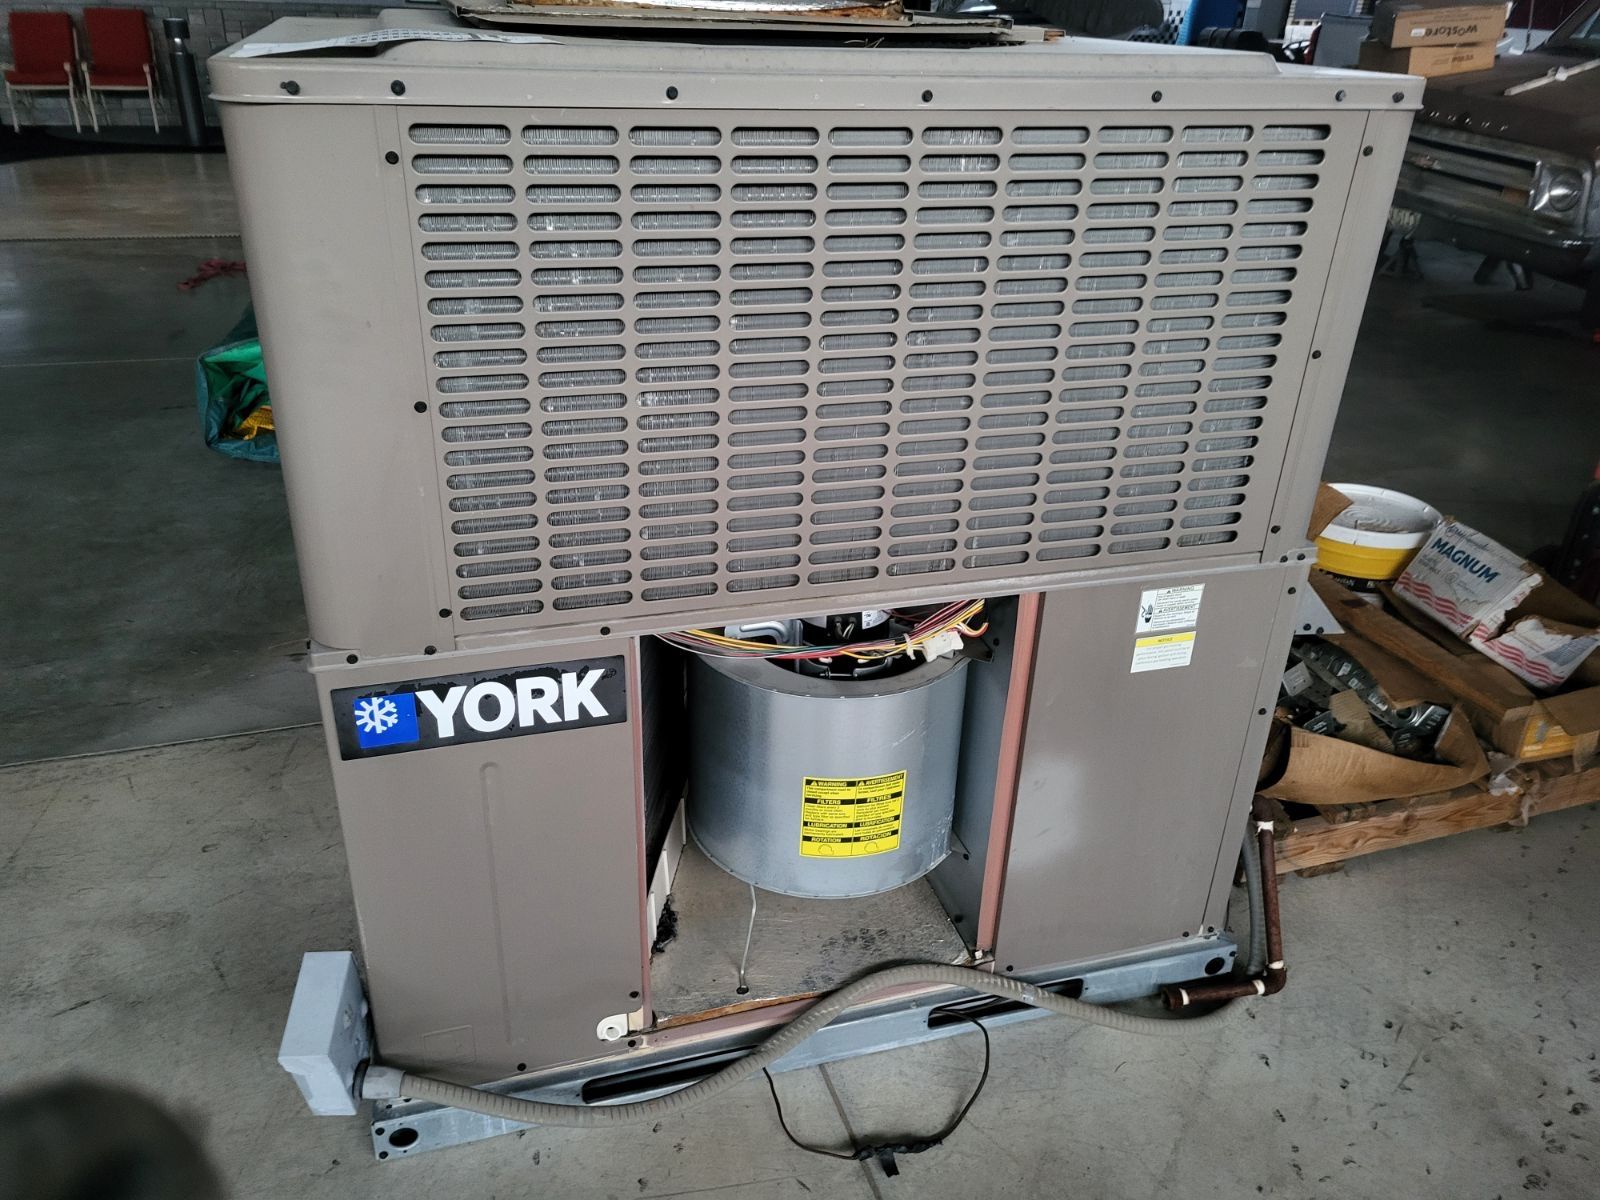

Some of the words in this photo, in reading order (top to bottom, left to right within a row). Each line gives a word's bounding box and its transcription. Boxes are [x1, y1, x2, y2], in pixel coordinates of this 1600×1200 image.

[1430, 537, 1501, 584] MAGNUM
[415, 668, 609, 738] YORK
[865, 774, 904, 786] AVERTISSEMENT
[866, 794, 892, 803] FILTRES
